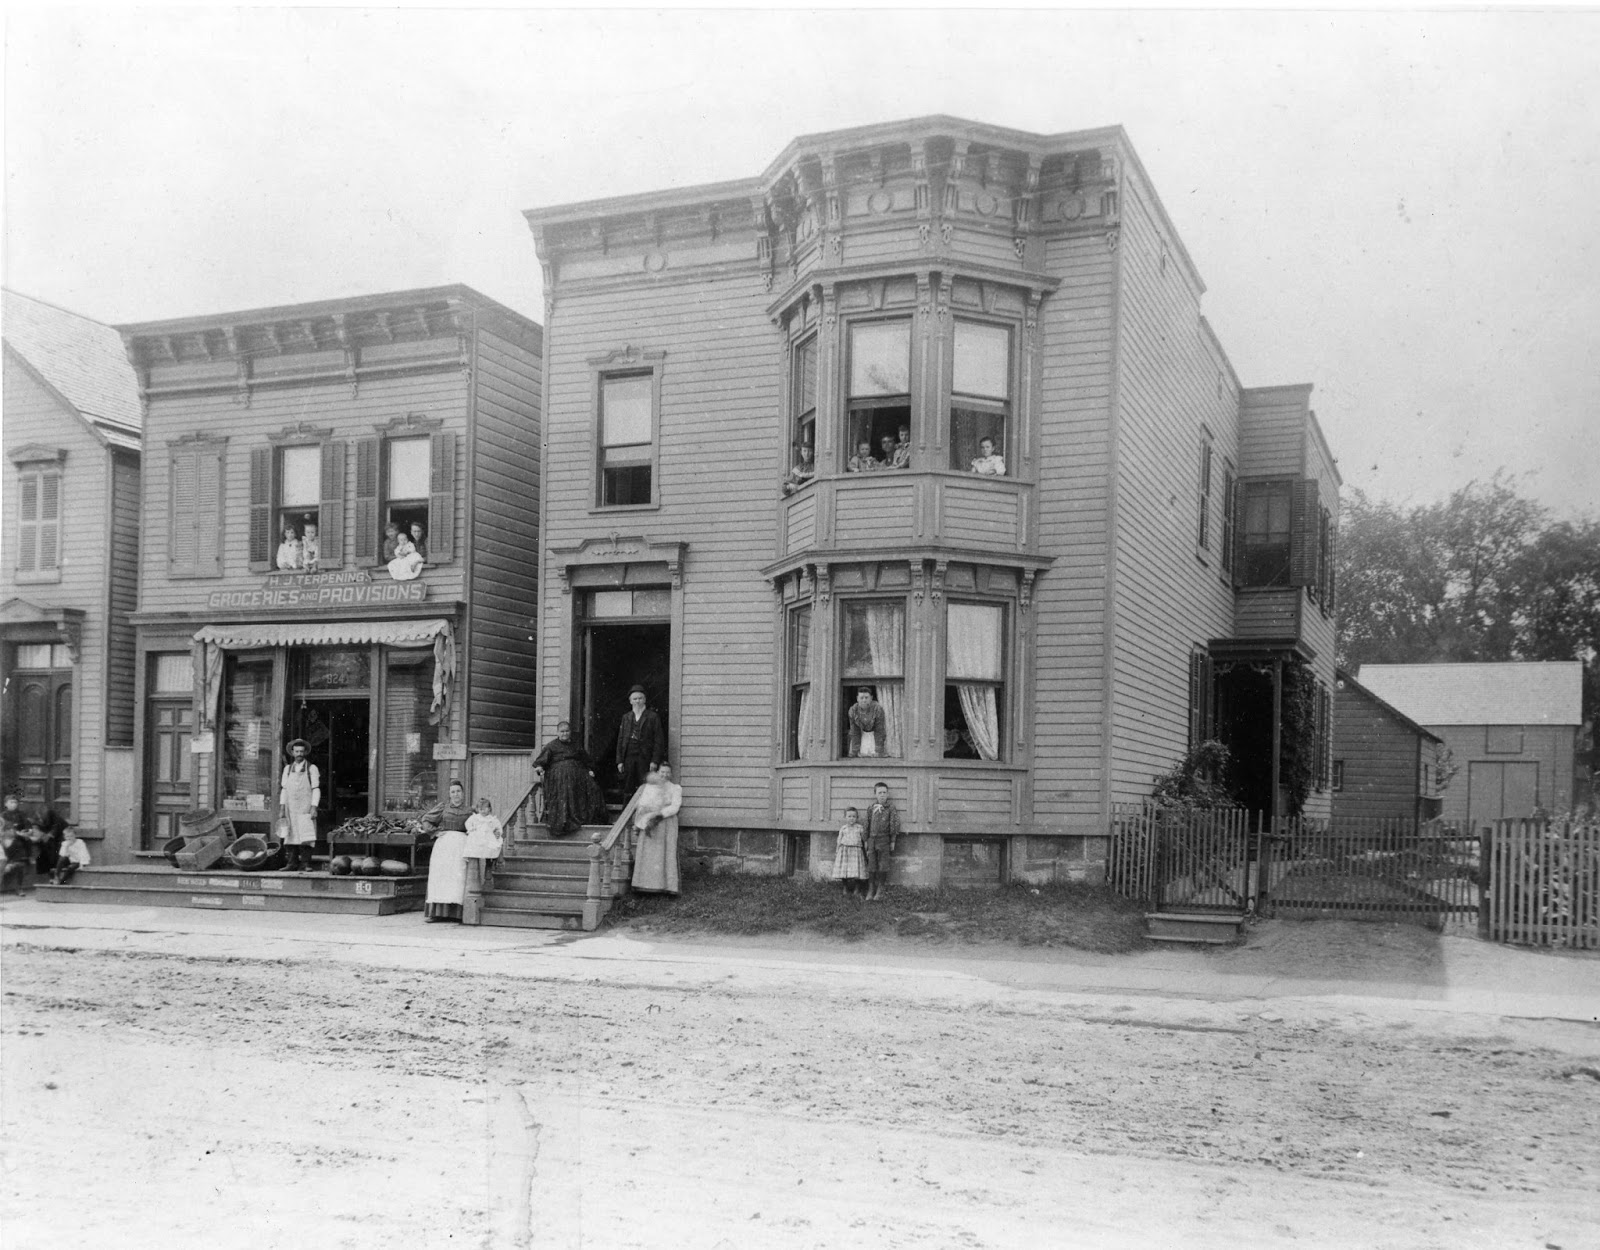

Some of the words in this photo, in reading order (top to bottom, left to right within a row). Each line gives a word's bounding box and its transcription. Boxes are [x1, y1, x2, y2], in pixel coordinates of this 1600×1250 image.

[209, 589, 299, 607] GROCERIES
[300, 592, 317, 601] AND
[319, 584, 422, 602] PROVISIONS
